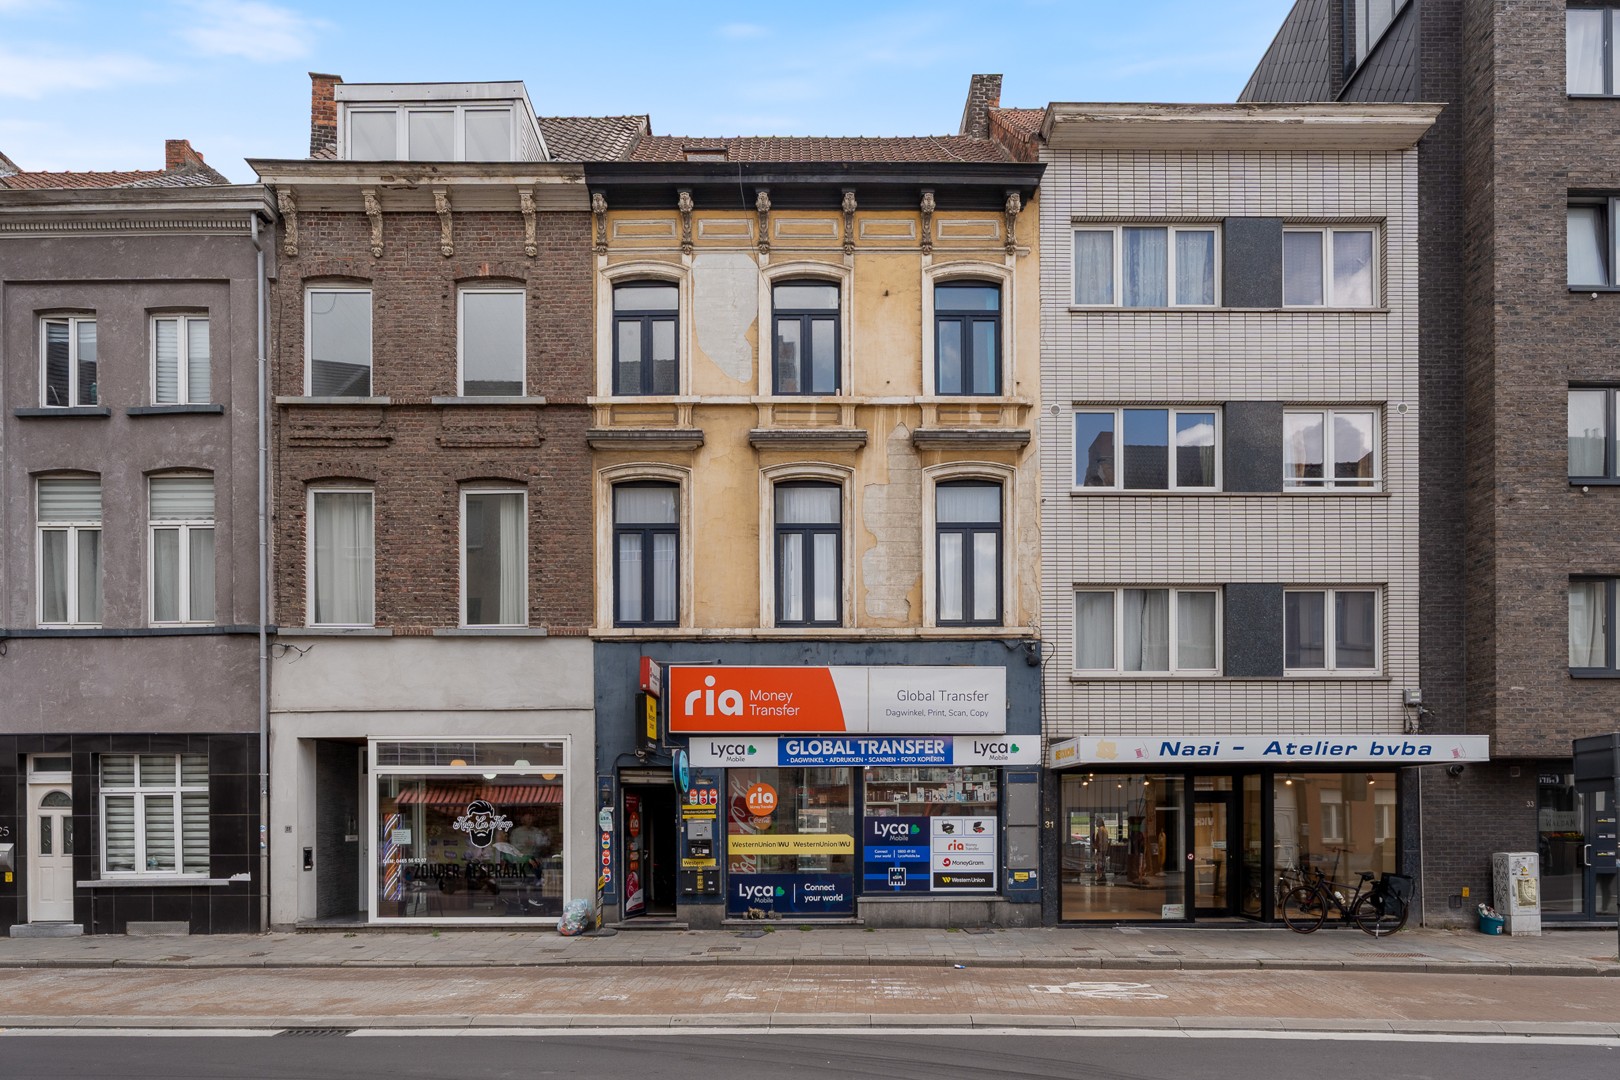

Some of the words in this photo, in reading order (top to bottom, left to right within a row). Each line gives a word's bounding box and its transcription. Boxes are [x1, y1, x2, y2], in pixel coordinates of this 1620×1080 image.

[685, 675, 743, 716] ria
[750, 689, 793, 703] Money
[897, 690, 935, 702] Global
[938, 690, 989, 702] Transfer
[749, 704, 800, 716] Transfer
[885, 709, 926, 718] Dagwinkel,
[927, 709, 947, 718] Print,
[948, 709, 968, 718] Scan,
[970, 709, 989, 718] Copy
[710, 742, 745, 758] Lyca
[785, 740, 855, 755] GLOBAL
[858, 739, 945, 755] TRANSFER
[974, 740, 1008, 759] Lyca
[1159, 741, 1220, 756] Naai
[1262, 740, 1358, 756] Atelier
[1369, 741, 1432, 756] bvba
[749, 787, 774, 804] ria
[1526, 800, 1535, 808] 33
[874, 821, 909, 837] Lyca
[1044, 820, 1054, 829] 31
[947, 839, 964, 850] ria
[414, 863, 460, 879] ZONDER
[464, 862, 527, 879] AFSPRAAK
[739, 883, 774, 899] Lyca
[804, 883, 836, 891] Connect
[804, 895, 821, 903] your
[821, 894, 844, 902] world
